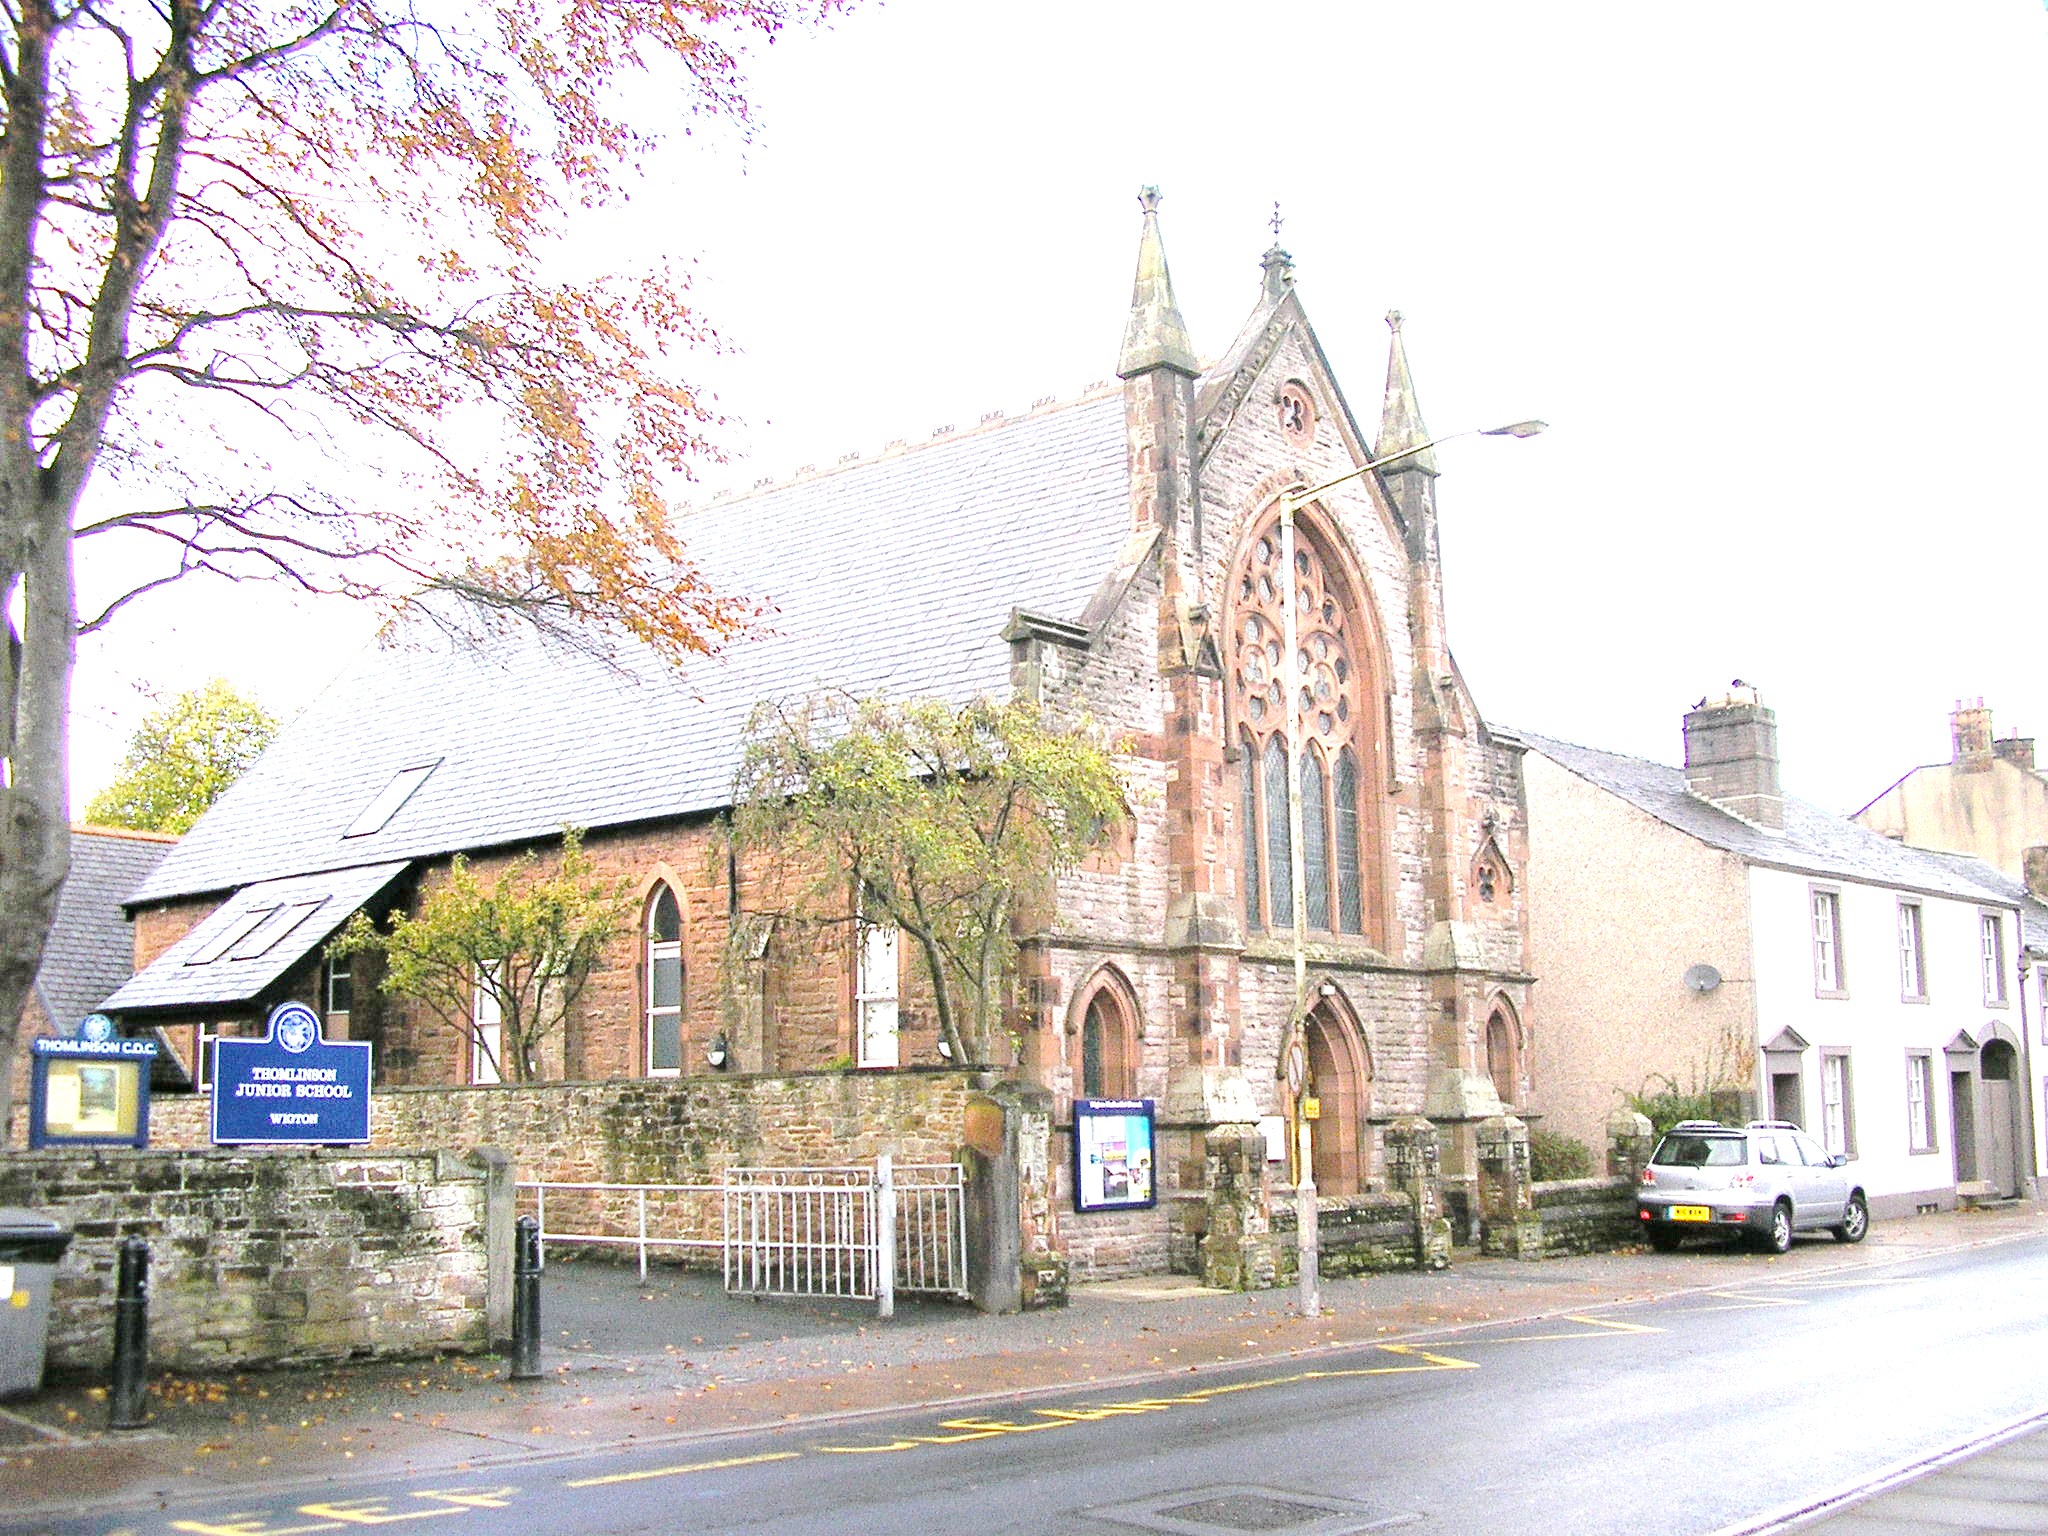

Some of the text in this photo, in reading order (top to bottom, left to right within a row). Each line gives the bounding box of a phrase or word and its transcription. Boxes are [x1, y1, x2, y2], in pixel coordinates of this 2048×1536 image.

[36, 1039, 120, 1053] THOMLINSON
[252, 1067, 337, 1082] THOMLINSON
[235, 1083, 352, 1098] JUNIOR SCHOOL
[270, 1113, 319, 1125] WIGTON
[105, 1486, 521, 1536] EEP
